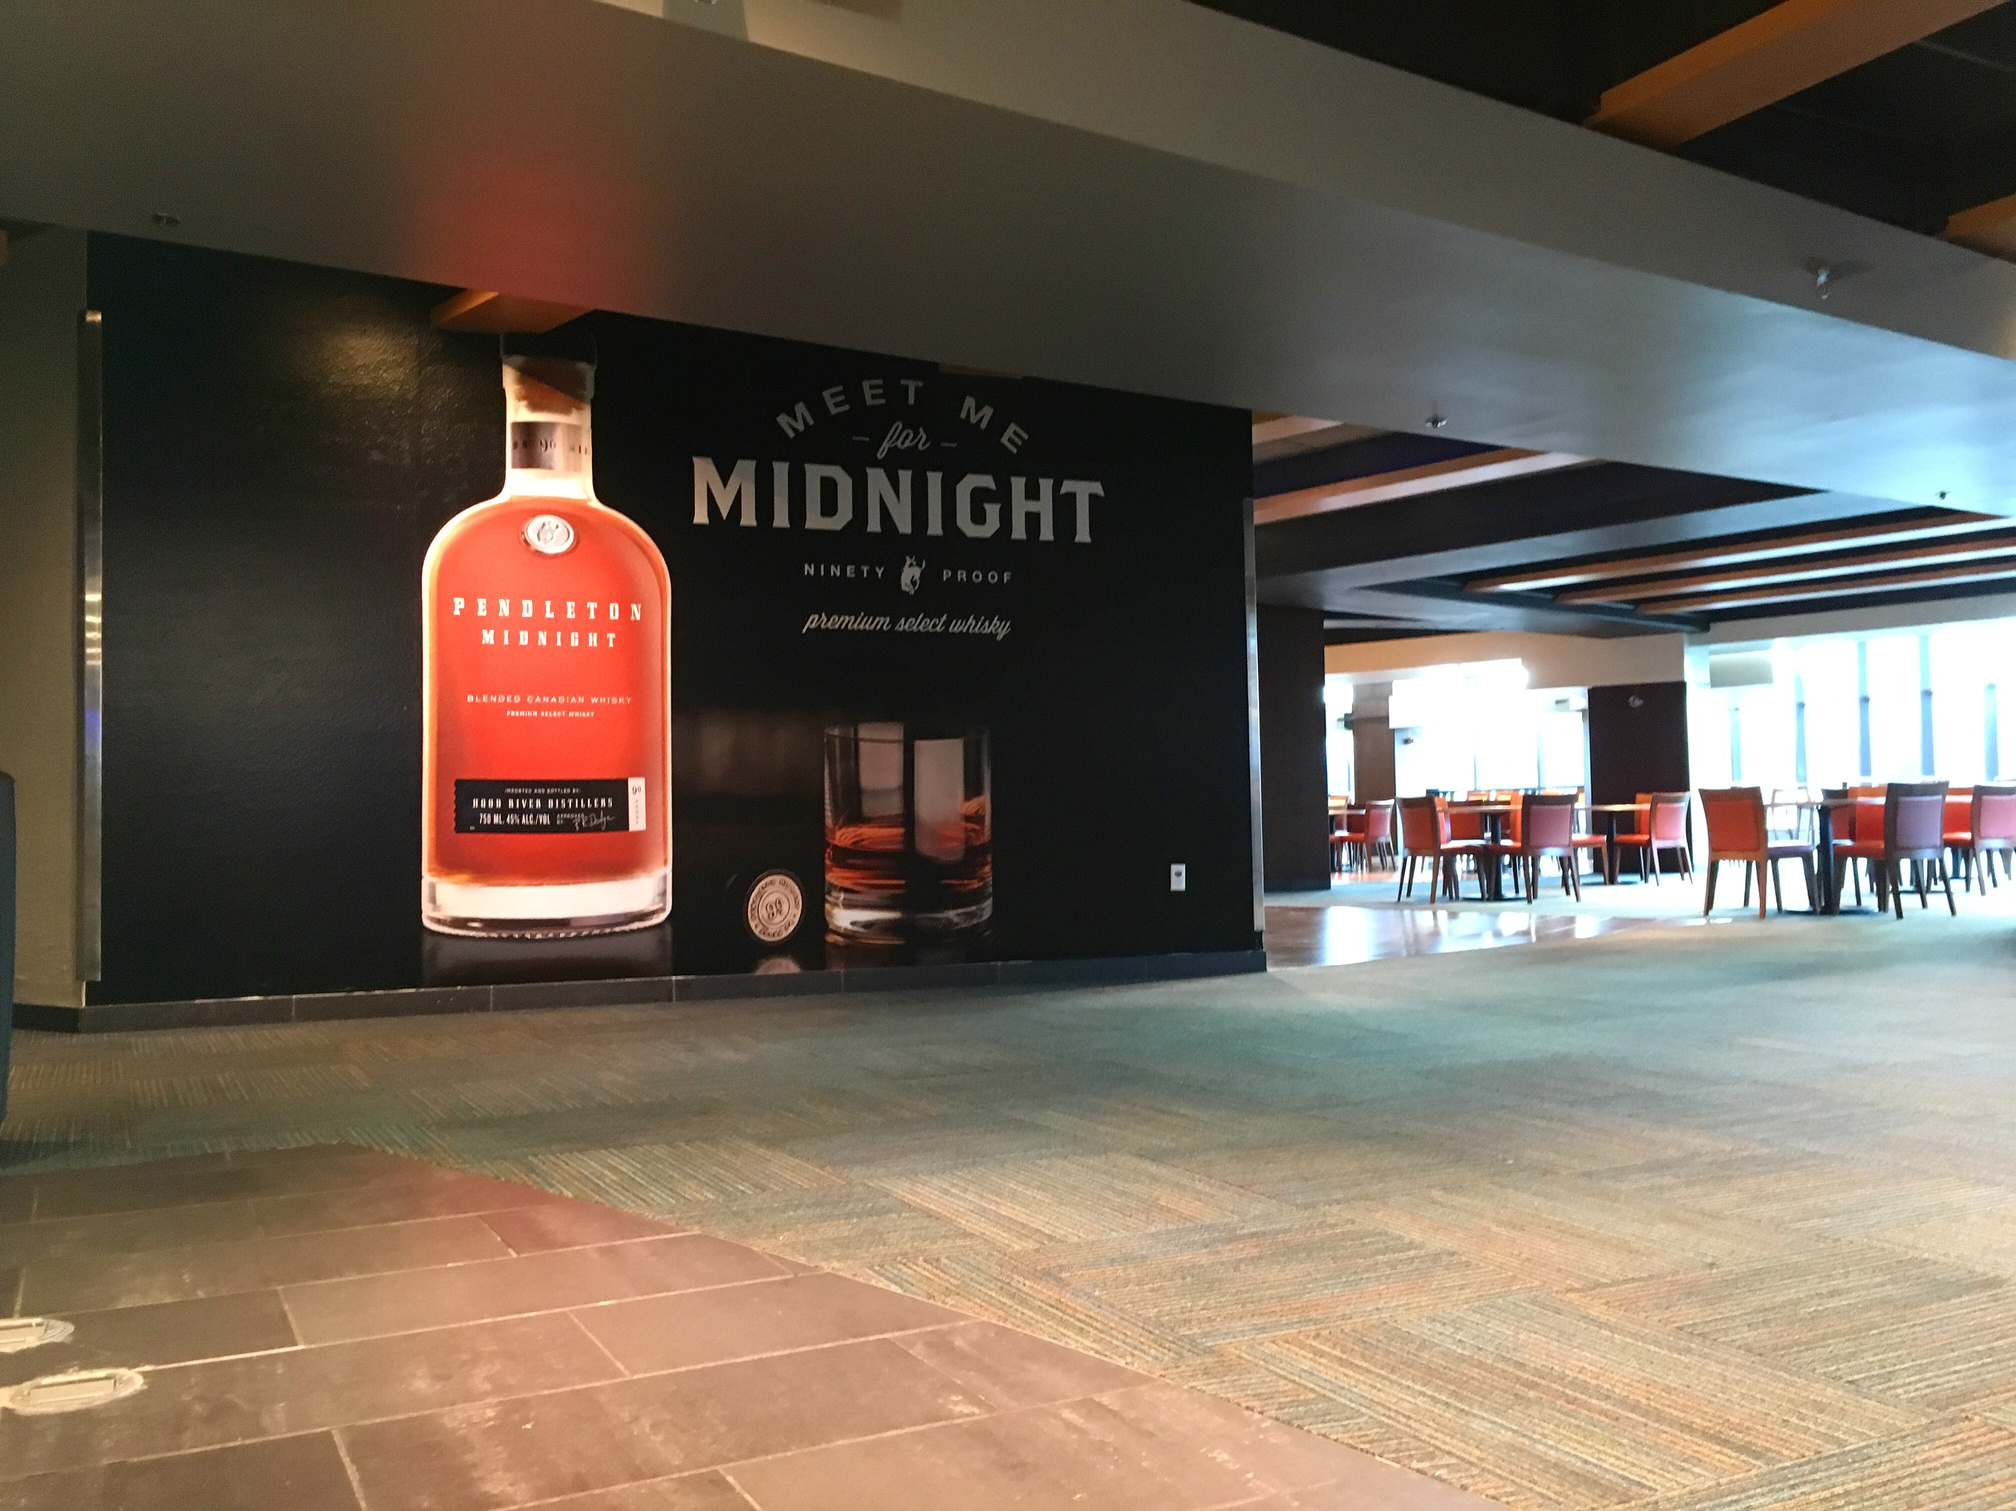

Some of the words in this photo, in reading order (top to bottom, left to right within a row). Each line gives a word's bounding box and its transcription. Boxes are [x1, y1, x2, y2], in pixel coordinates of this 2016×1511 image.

[775, 379, 924, 439] MEET
[959, 395, 1029, 454] ME
[876, 421, 930, 460] for
[692, 455, 1106, 544] MIDNIGHT
[803, 562, 885, 579] NINETY
[942, 569, 1013, 584] PROOF
[453, 597, 642, 621] PENDLETON
[801, 612, 892, 634] premium
[894, 612, 948, 633] select
[948, 614, 1012, 641] whisky
[481, 629, 616, 648] MIDNIGHT
[467, 694, 521, 704] BLENDED
[527, 695, 585, 705] CANADIAN
[590, 696, 632, 705] WHISKY
[472, 798, 502, 810] HOOD
[508, 798, 542, 810] RIVER
[548, 797, 613, 810] DISTILLERS
[479, 812, 492, 825] 750
